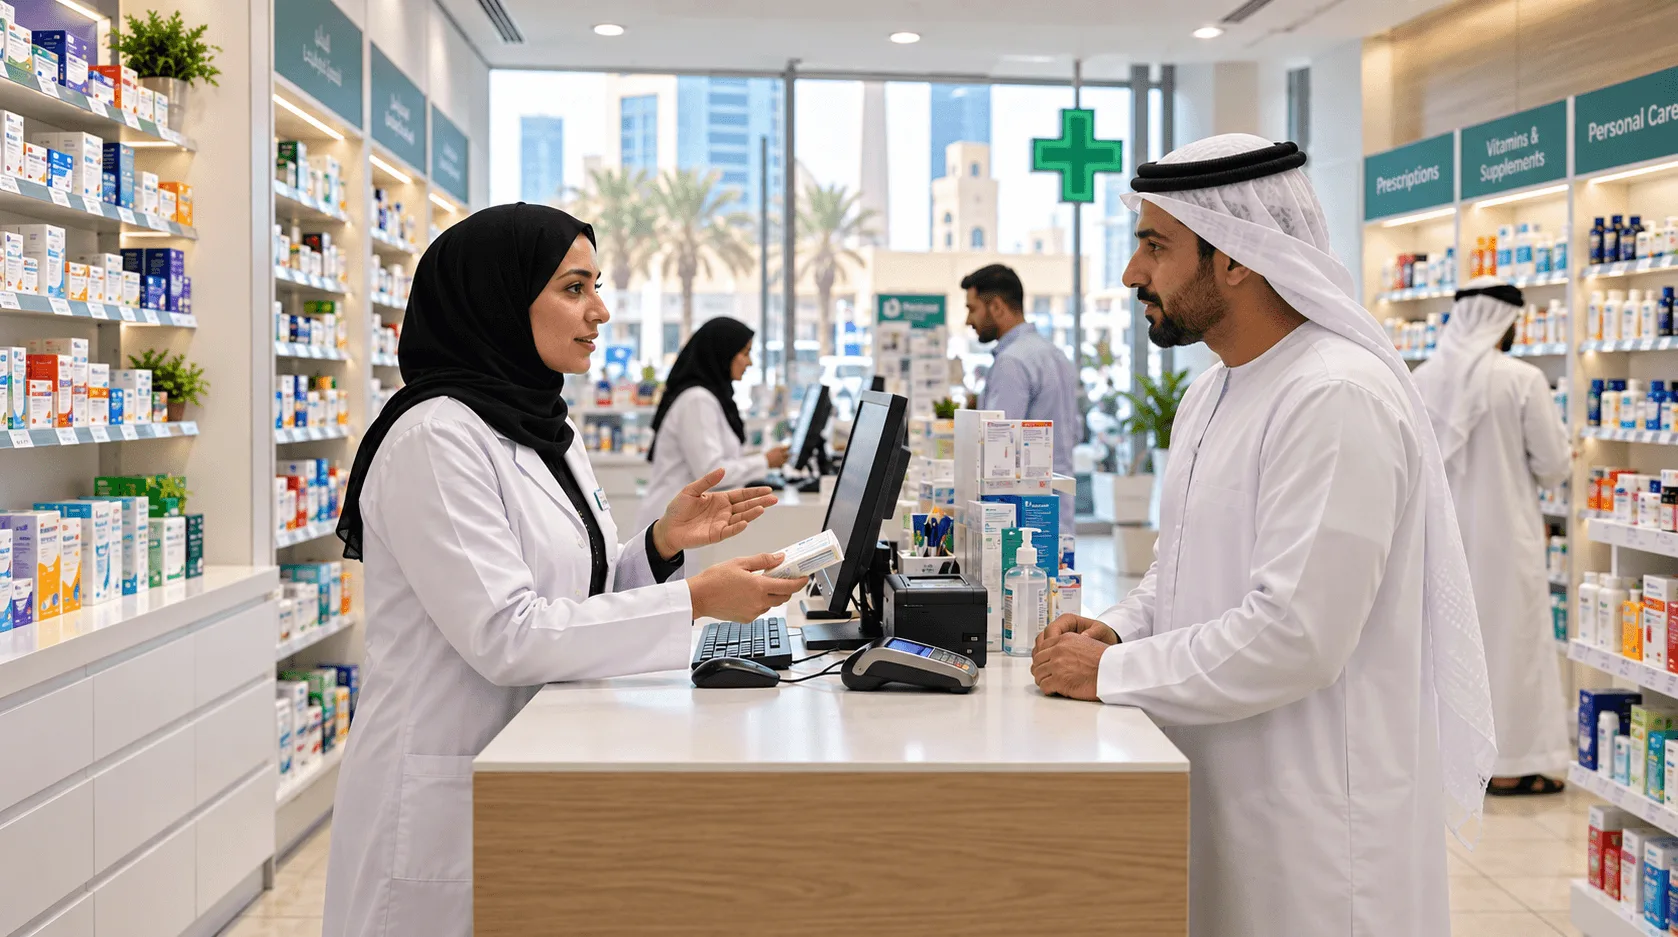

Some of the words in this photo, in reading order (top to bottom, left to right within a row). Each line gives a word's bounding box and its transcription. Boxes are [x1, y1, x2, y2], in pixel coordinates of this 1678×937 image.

[1588, 107, 1644, 143] Personal
[1647, 103, 1678, 126] Care
[1486, 131, 1529, 157] Vitamins
[1530, 126, 1539, 145] &
[1376, 164, 1440, 196] Prescriptions
[1480, 150, 1545, 184] Supplements
